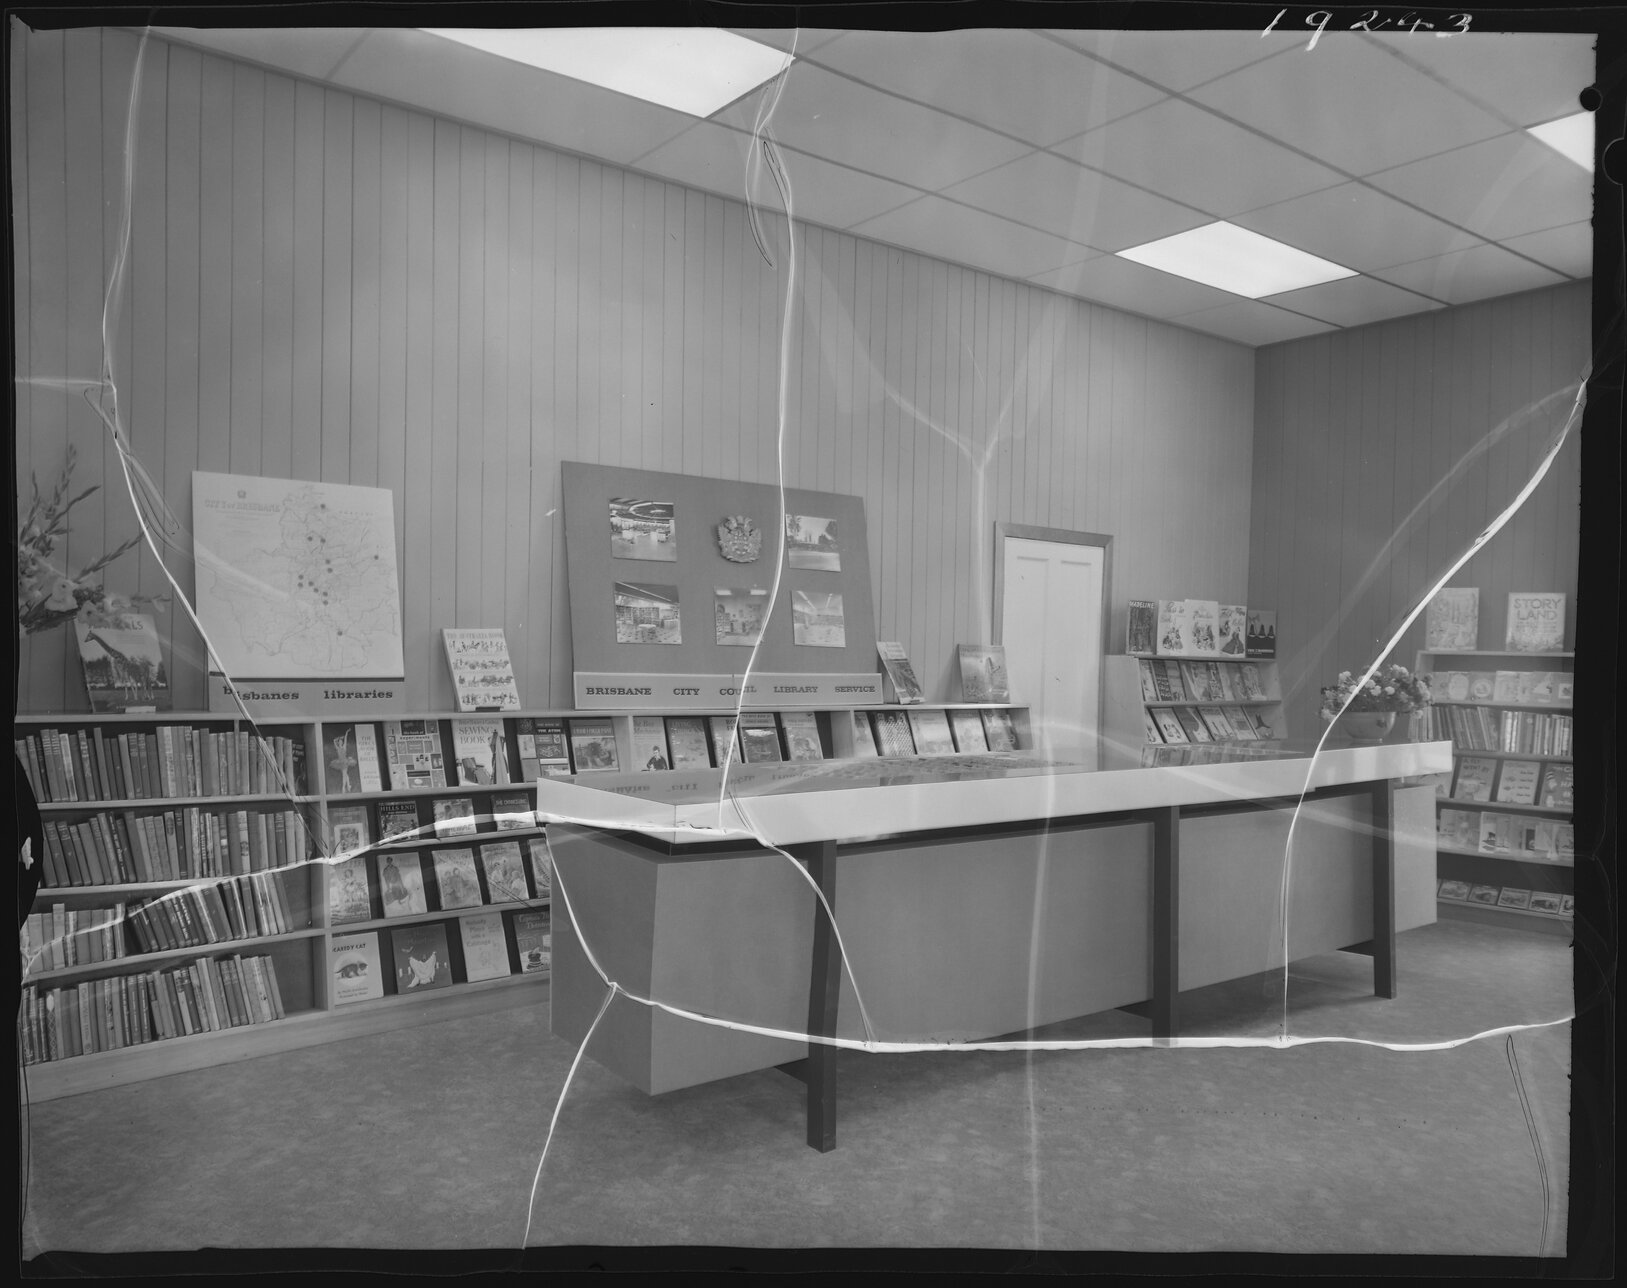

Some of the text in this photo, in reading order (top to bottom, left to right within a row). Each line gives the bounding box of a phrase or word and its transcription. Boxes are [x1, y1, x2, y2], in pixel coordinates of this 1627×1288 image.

[1514, 598, 1562, 610] STORY
[1517, 610, 1558, 621] LAND
[222, 686, 393, 700] bisbanes libraries
[586, 687, 652, 696] BRISBANE
[673, 687, 700, 696] CITY
[773, 685, 819, 694] LIBRARY
[834, 685, 876, 693] SERVICE
[459, 736, 486, 744] BOOK
